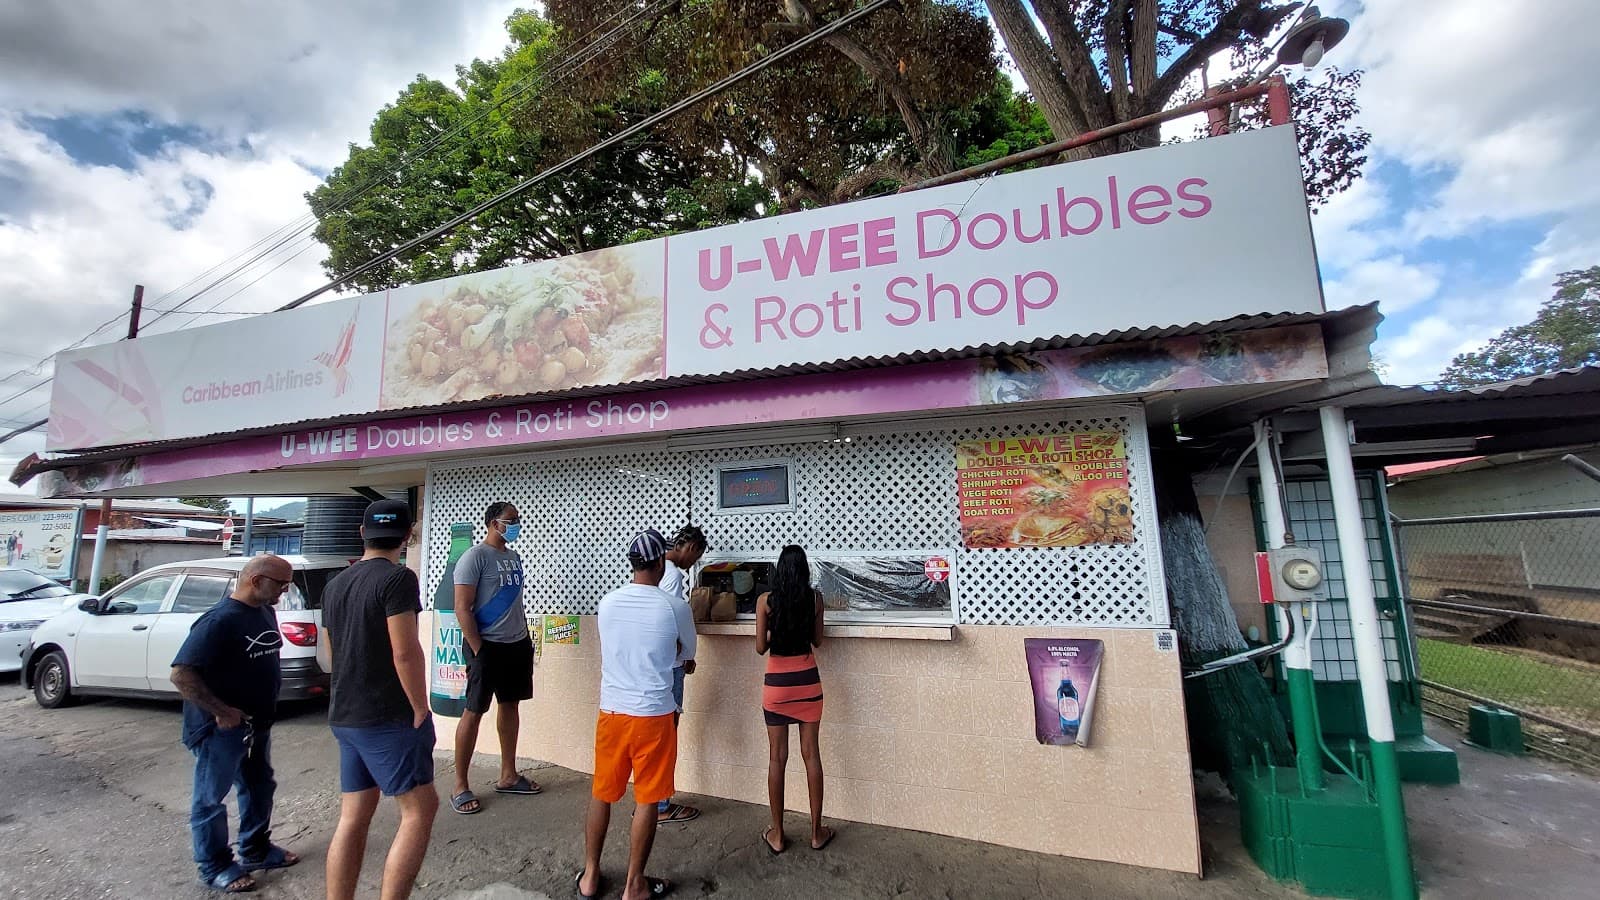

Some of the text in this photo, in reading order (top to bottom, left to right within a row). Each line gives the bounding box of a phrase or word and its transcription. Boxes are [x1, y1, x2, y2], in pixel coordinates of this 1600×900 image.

[698, 175, 1212, 292] U-WEE Doubles
[699, 270, 1059, 350] & Roti Shop
[281, 399, 669, 458] U-WEE Doubles & Roti Shop
[984, 434, 1092, 456] U-WEE
[966, 454, 1025, 467] DOUBLES
[1029, 453, 1039, 464] &
[1042, 451, 1073, 463] ROTI
[1073, 461, 1123, 471] DOUBLES
[961, 468, 1029, 479] CHICKEN ROTI
[1073, 471, 1124, 481] ALOO PIE
[961, 478, 1023, 488] SHRIMP ROTI
[962, 488, 1012, 498] VEGE ROTI
[989, 498, 1012, 506] ROTI
[963, 507, 1014, 517] GOAT ROTI
[500, 573, 522, 587] 198
[547, 622, 576, 635] REFRESH
[440, 627, 463, 646] VIT
[554, 630, 573, 641] JUICE
[439, 666, 467, 680] Class
